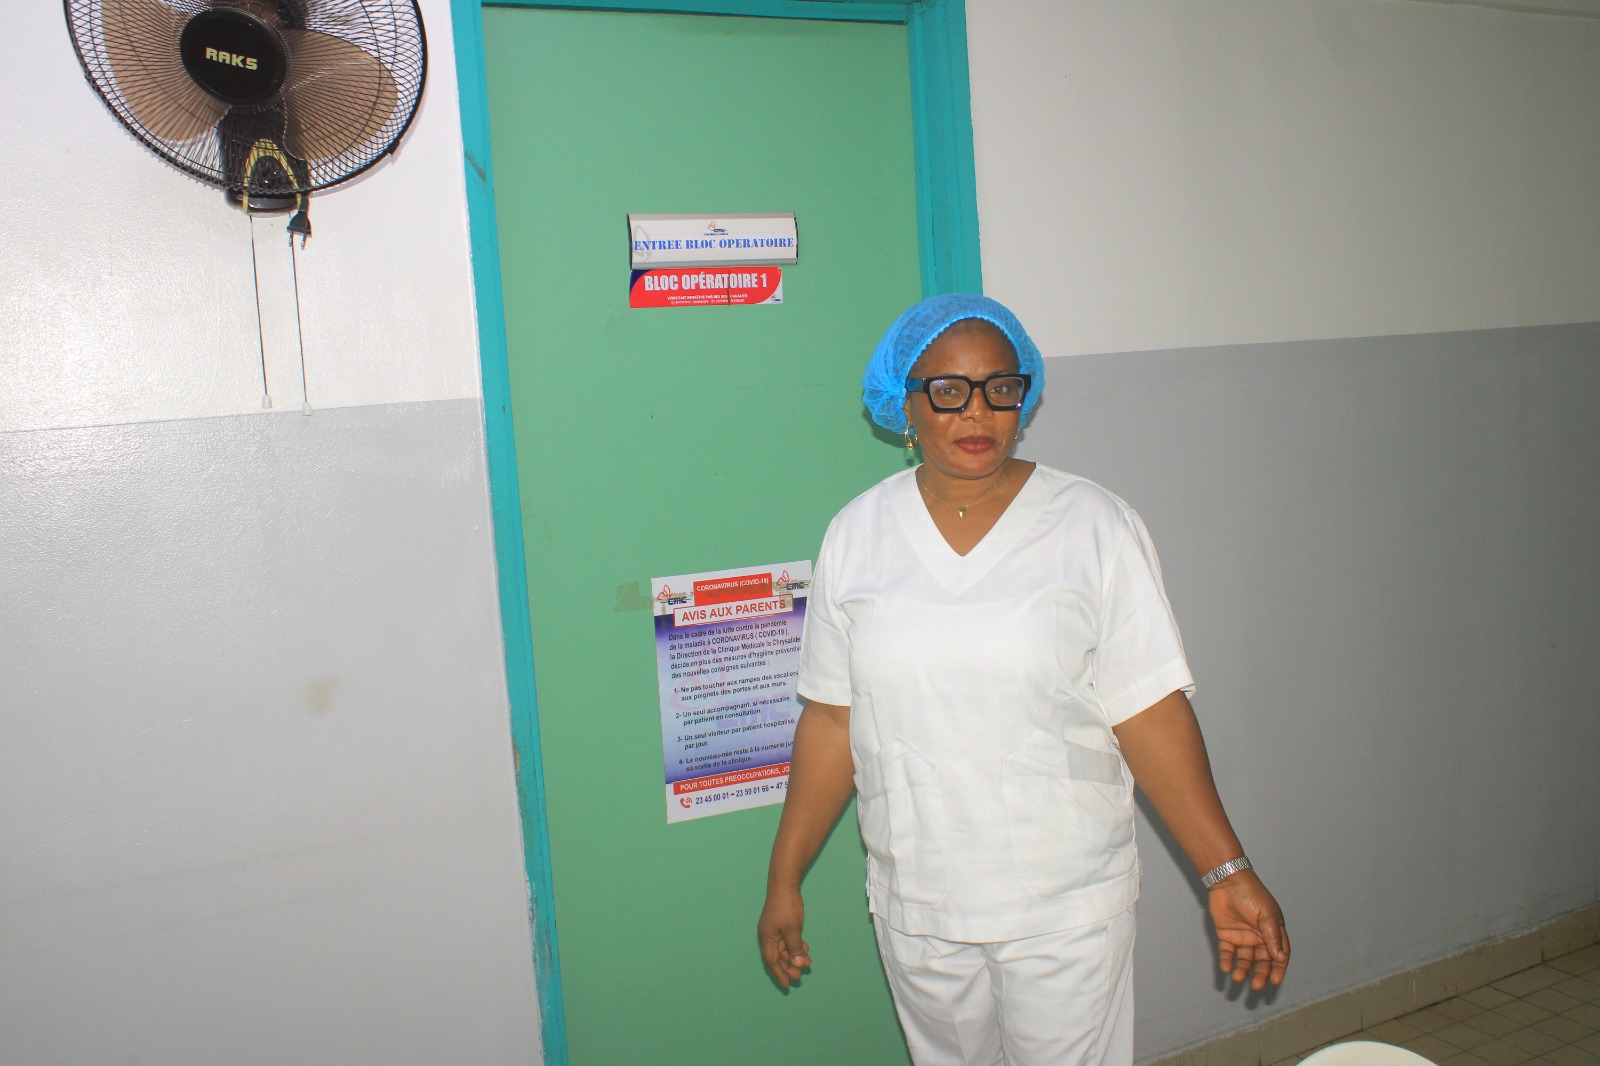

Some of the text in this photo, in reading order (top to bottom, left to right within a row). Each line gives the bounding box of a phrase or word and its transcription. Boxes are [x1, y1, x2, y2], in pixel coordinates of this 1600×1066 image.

[205, 46, 258, 71] RAKS
[633, 237, 794, 251] ENTREE BLOC OPERATOIRE
[644, 271, 767, 291] BLOC OPÉRATOIRE 1
[697, 578, 769, 592] CORONAVIRUS (COVID-19)
[682, 599, 786, 622] AVIS AUX PARENTS
[736, 624, 753, 632] contre
[684, 640, 705, 648] maladie
[712, 633, 754, 645] CORONAVIRUS
[677, 650, 702, 660] Direction
[718, 645, 740, 654] Clinique
[741, 642, 765, 650] Médicale
[773, 636, 800, 646] Chrysalide
[724, 654, 746, 662] mesures
[683, 668, 710, 677] nouvelles
[711, 664, 739, 673] consignes
[740, 660, 766, 669] suivantes
[691, 685, 701, 693] pas
[703, 681, 726, 690] toucher
[739, 676, 760, 684] rampes
[694, 690, 719, 700] poignets
[733, 687, 751, 695] portes
[694, 716, 715, 725] patient
[708, 729, 730, 737] visiteur
[742, 724, 762, 732] patient
[761, 742, 784, 751] nurserie
[680, 782, 698, 791] POUR
[699, 777, 724, 787] TOUTES
[696, 796, 703, 805] 23
[722, 792, 729, 800] 01
